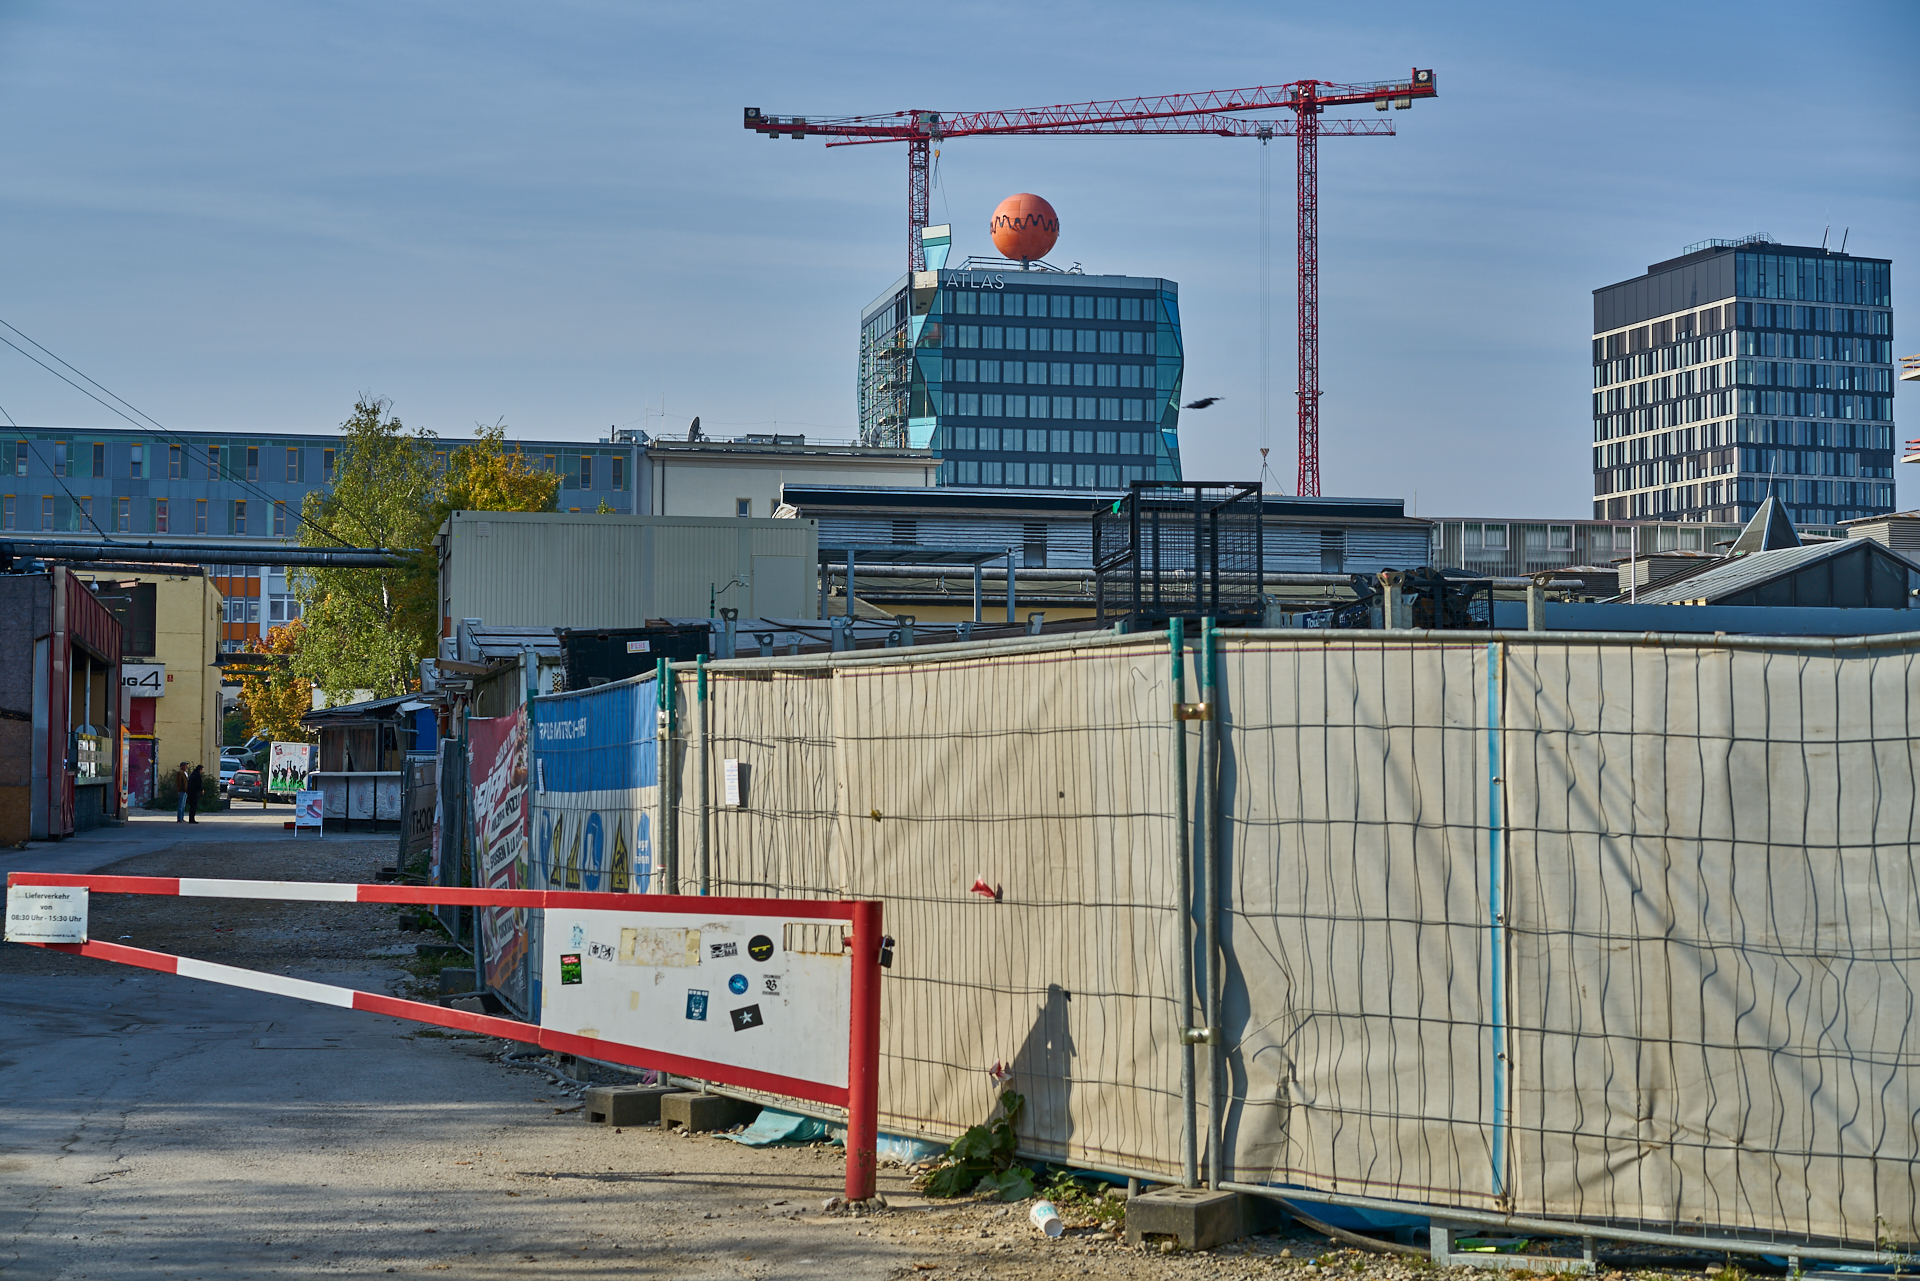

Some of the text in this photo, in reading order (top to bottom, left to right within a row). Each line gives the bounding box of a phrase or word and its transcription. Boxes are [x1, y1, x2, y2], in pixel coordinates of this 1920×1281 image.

[946, 272, 1005, 290] ATLAS
[630, 642, 646, 650] PERI
[24, 892, 71, 900] Lieferverkehr
